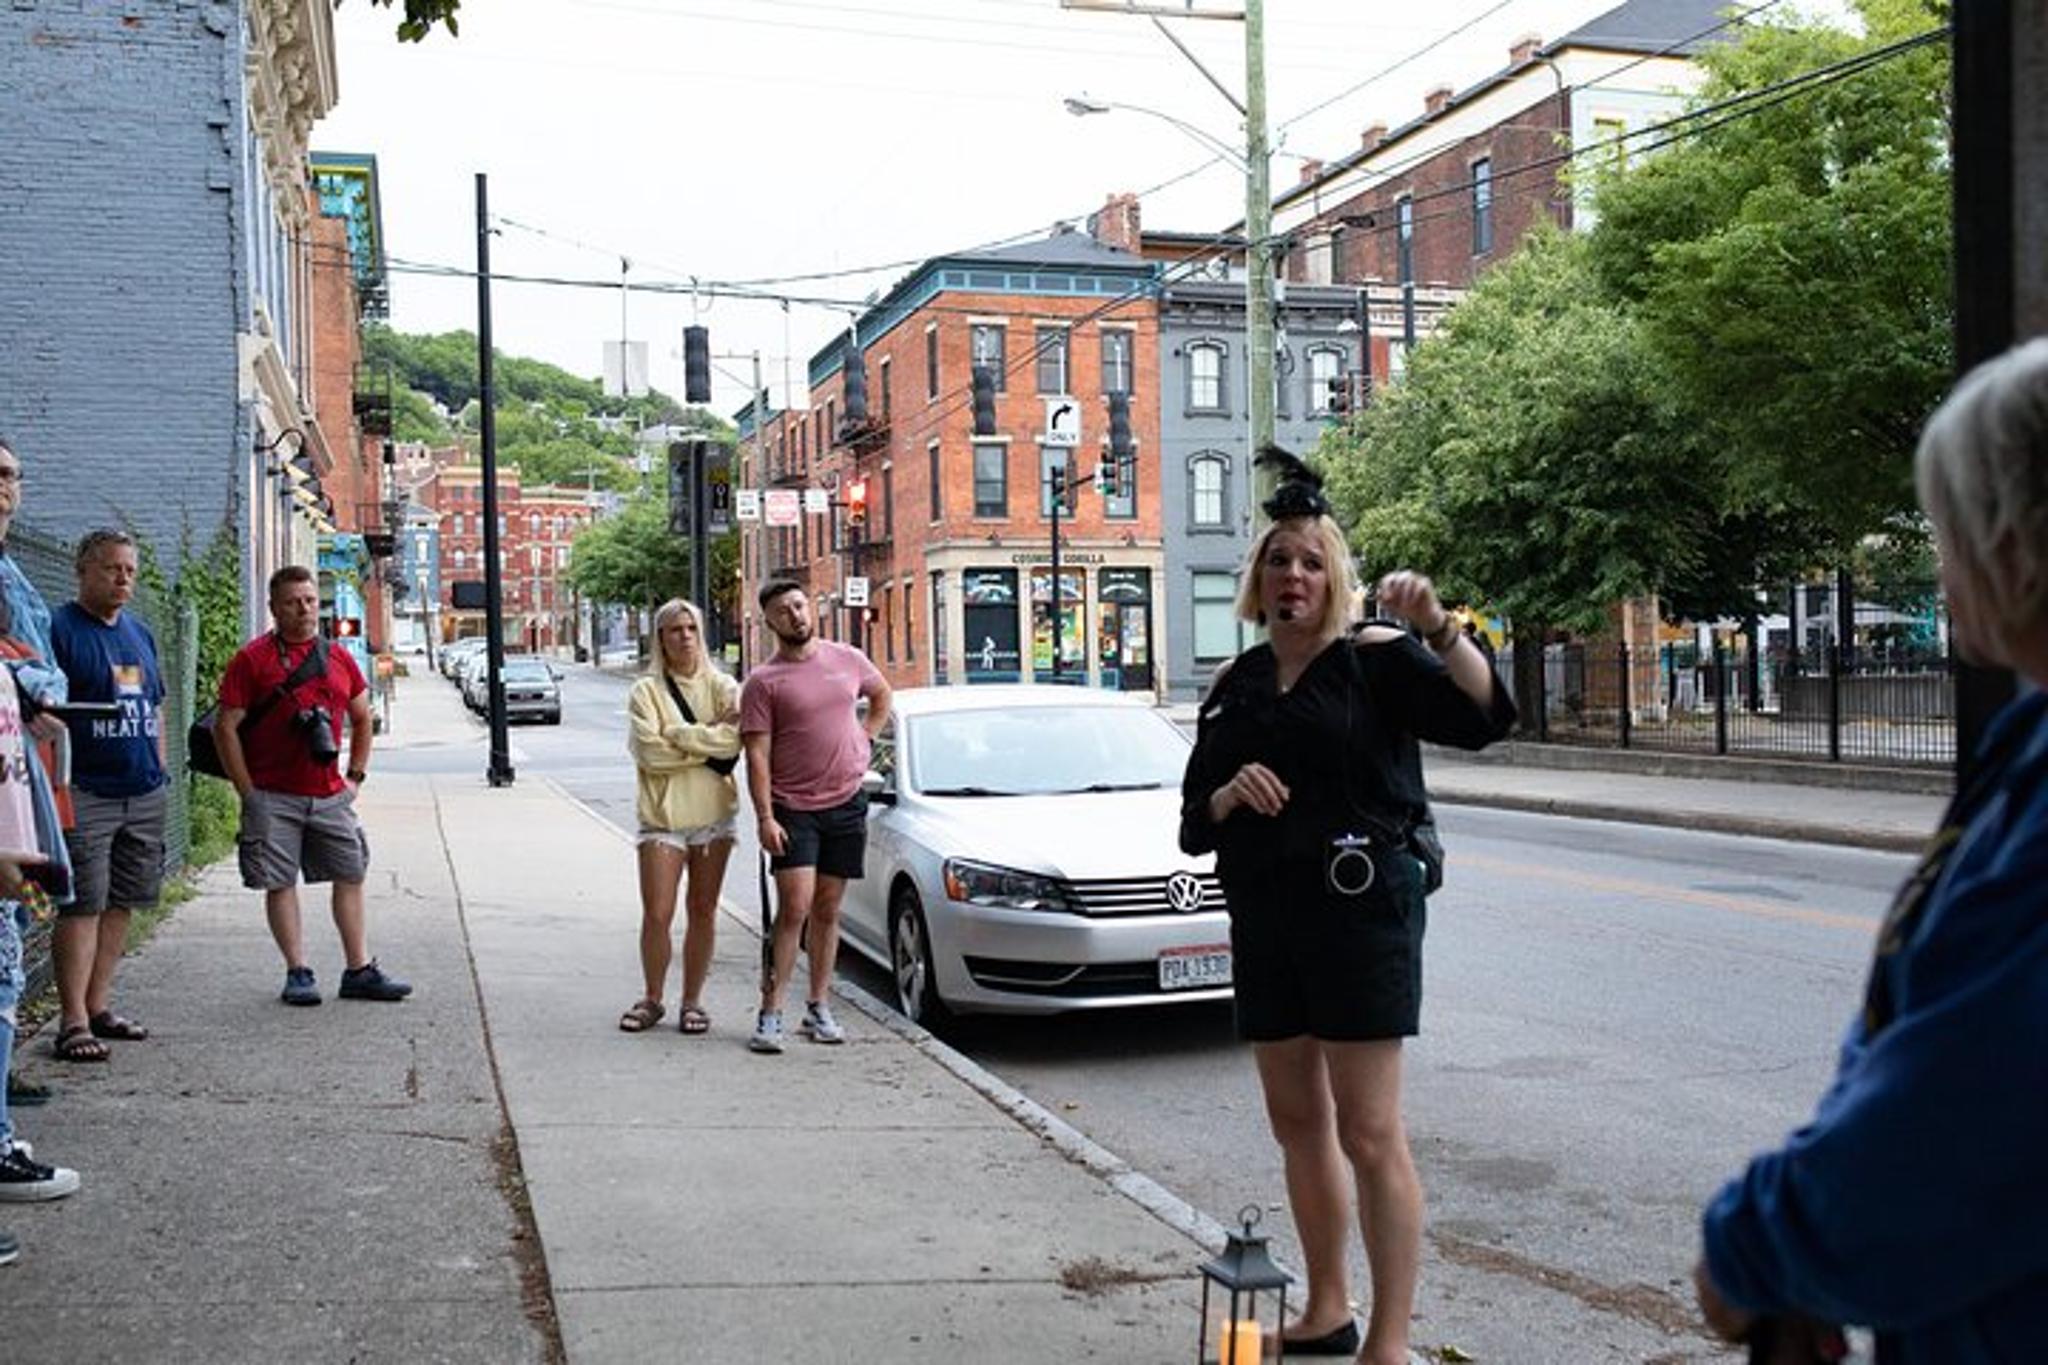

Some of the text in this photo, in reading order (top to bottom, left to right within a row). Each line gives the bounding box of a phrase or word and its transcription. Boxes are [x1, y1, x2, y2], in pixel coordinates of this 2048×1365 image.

[1050, 432, 1076, 441] ONLY
[1064, 554, 1105, 563] GORILLA
[93, 718, 139, 738] NEAT
